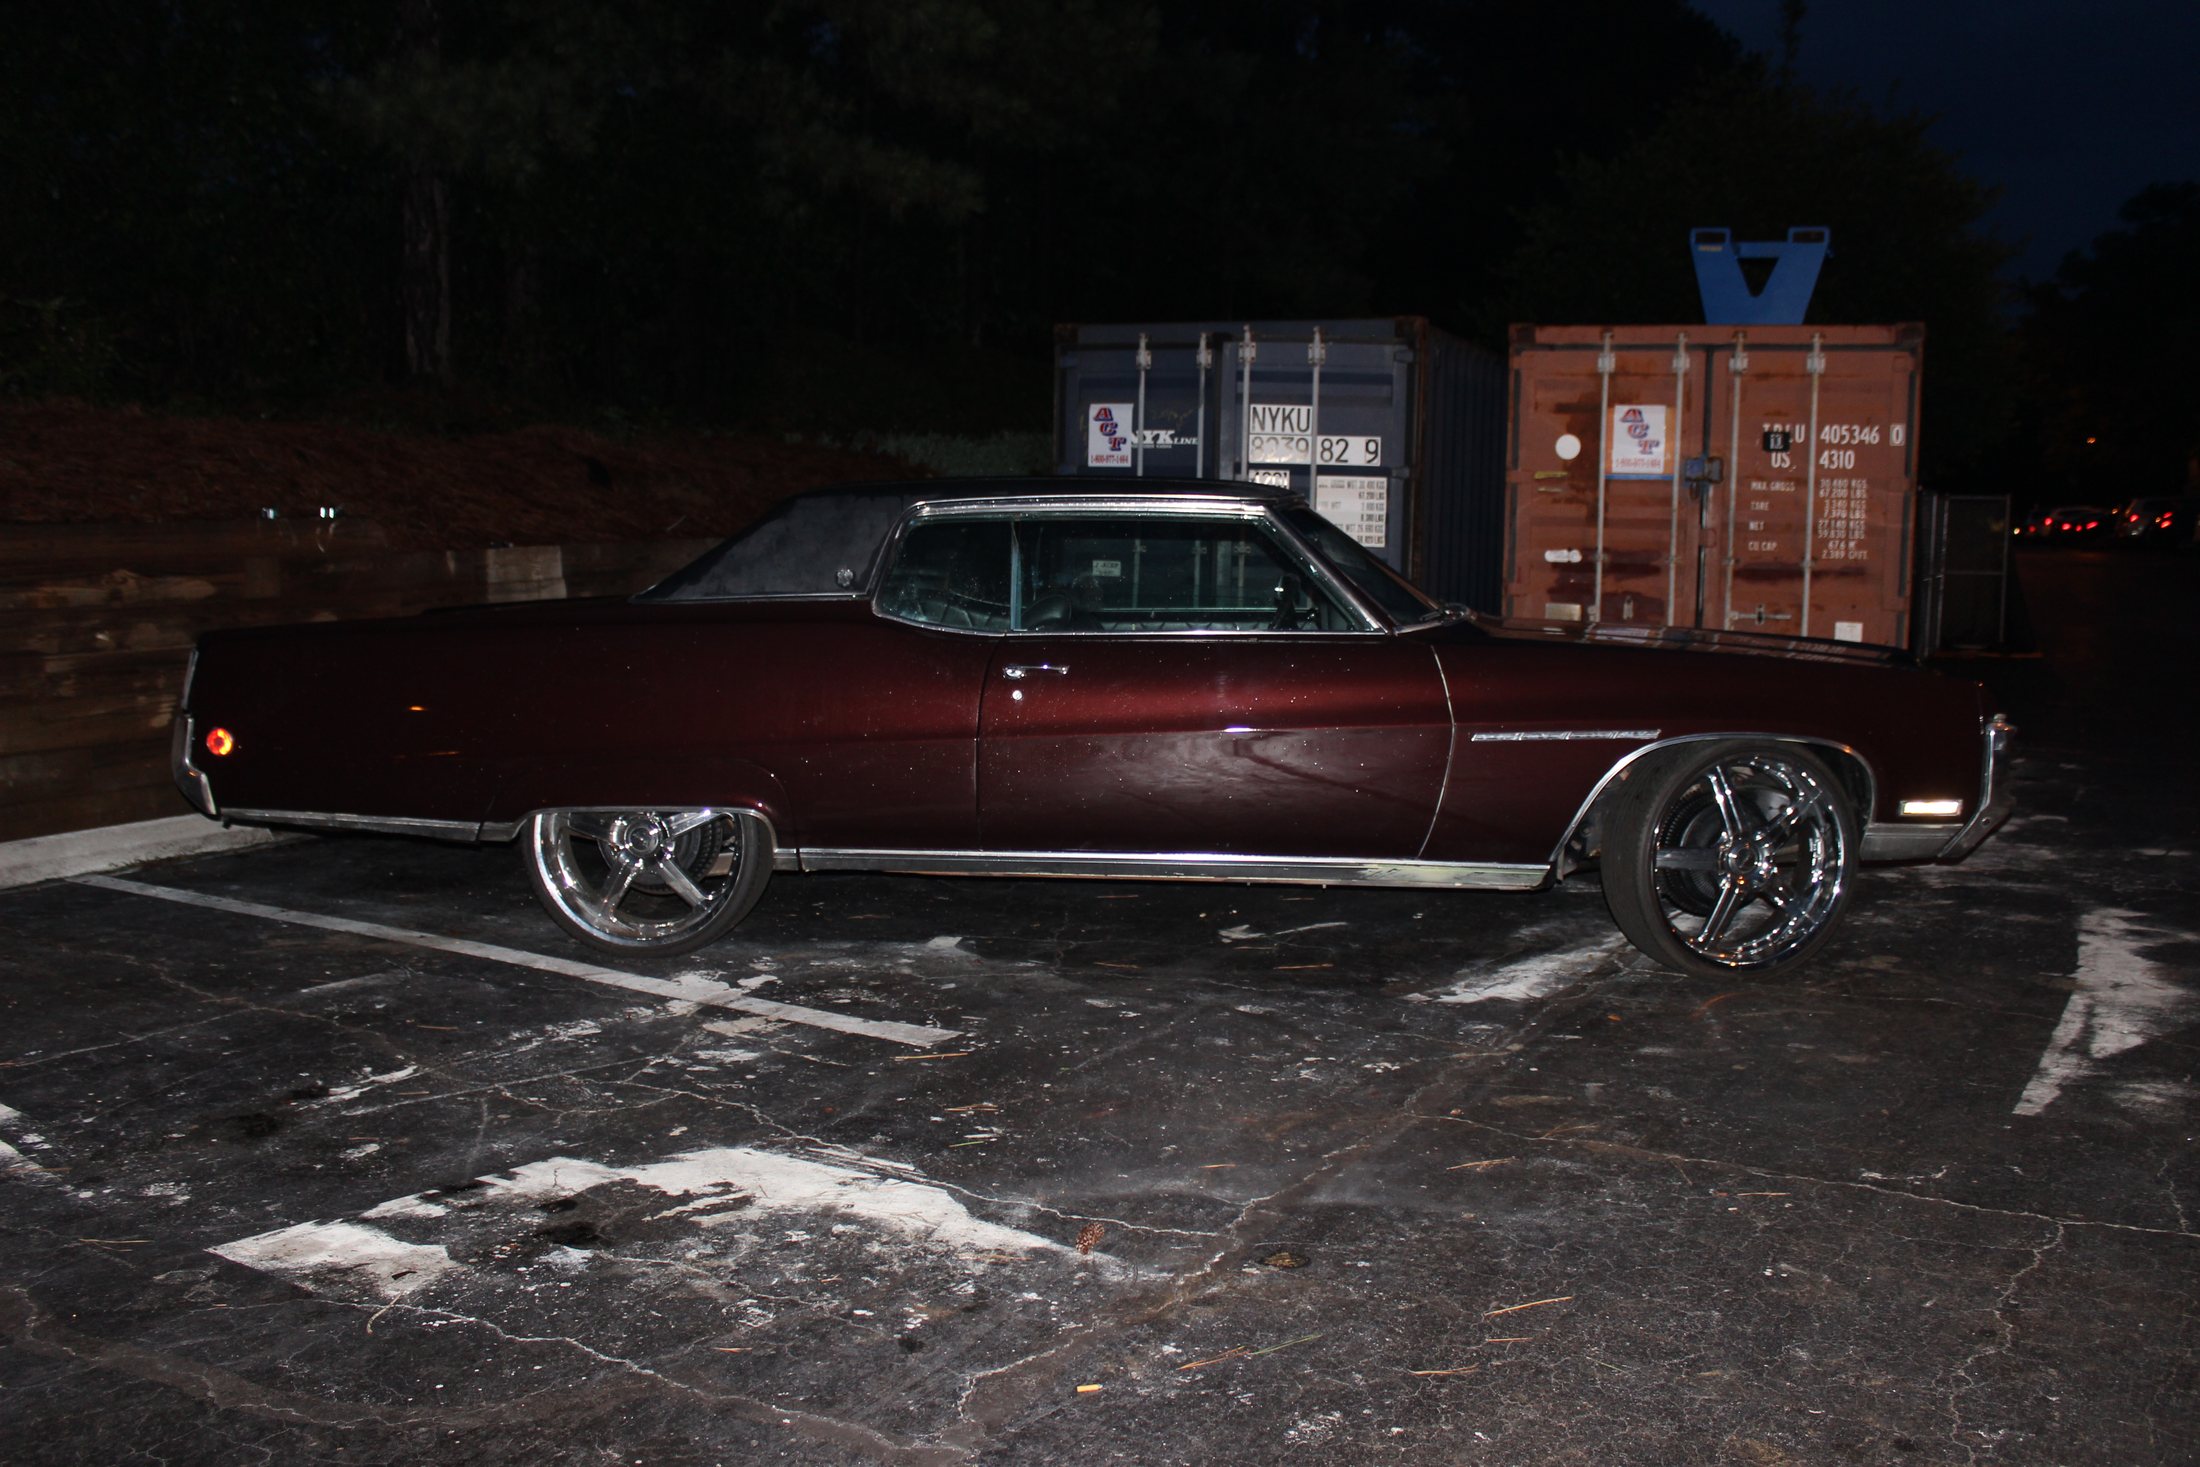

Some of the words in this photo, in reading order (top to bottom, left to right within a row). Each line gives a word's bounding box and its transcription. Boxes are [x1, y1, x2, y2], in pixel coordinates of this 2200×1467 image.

[1094, 407, 1127, 451] ACT
[1251, 406, 1311, 433] NYKU
[1620, 408, 1660, 455] ACT
[1820, 424, 1881, 444] 405346
[1891, 424, 1904, 445] 0
[1320, 438, 1349, 463] 82
[1365, 439, 1379, 463] 9
[1770, 452, 1791, 468] US
[1819, 449, 1856, 470] 4310
